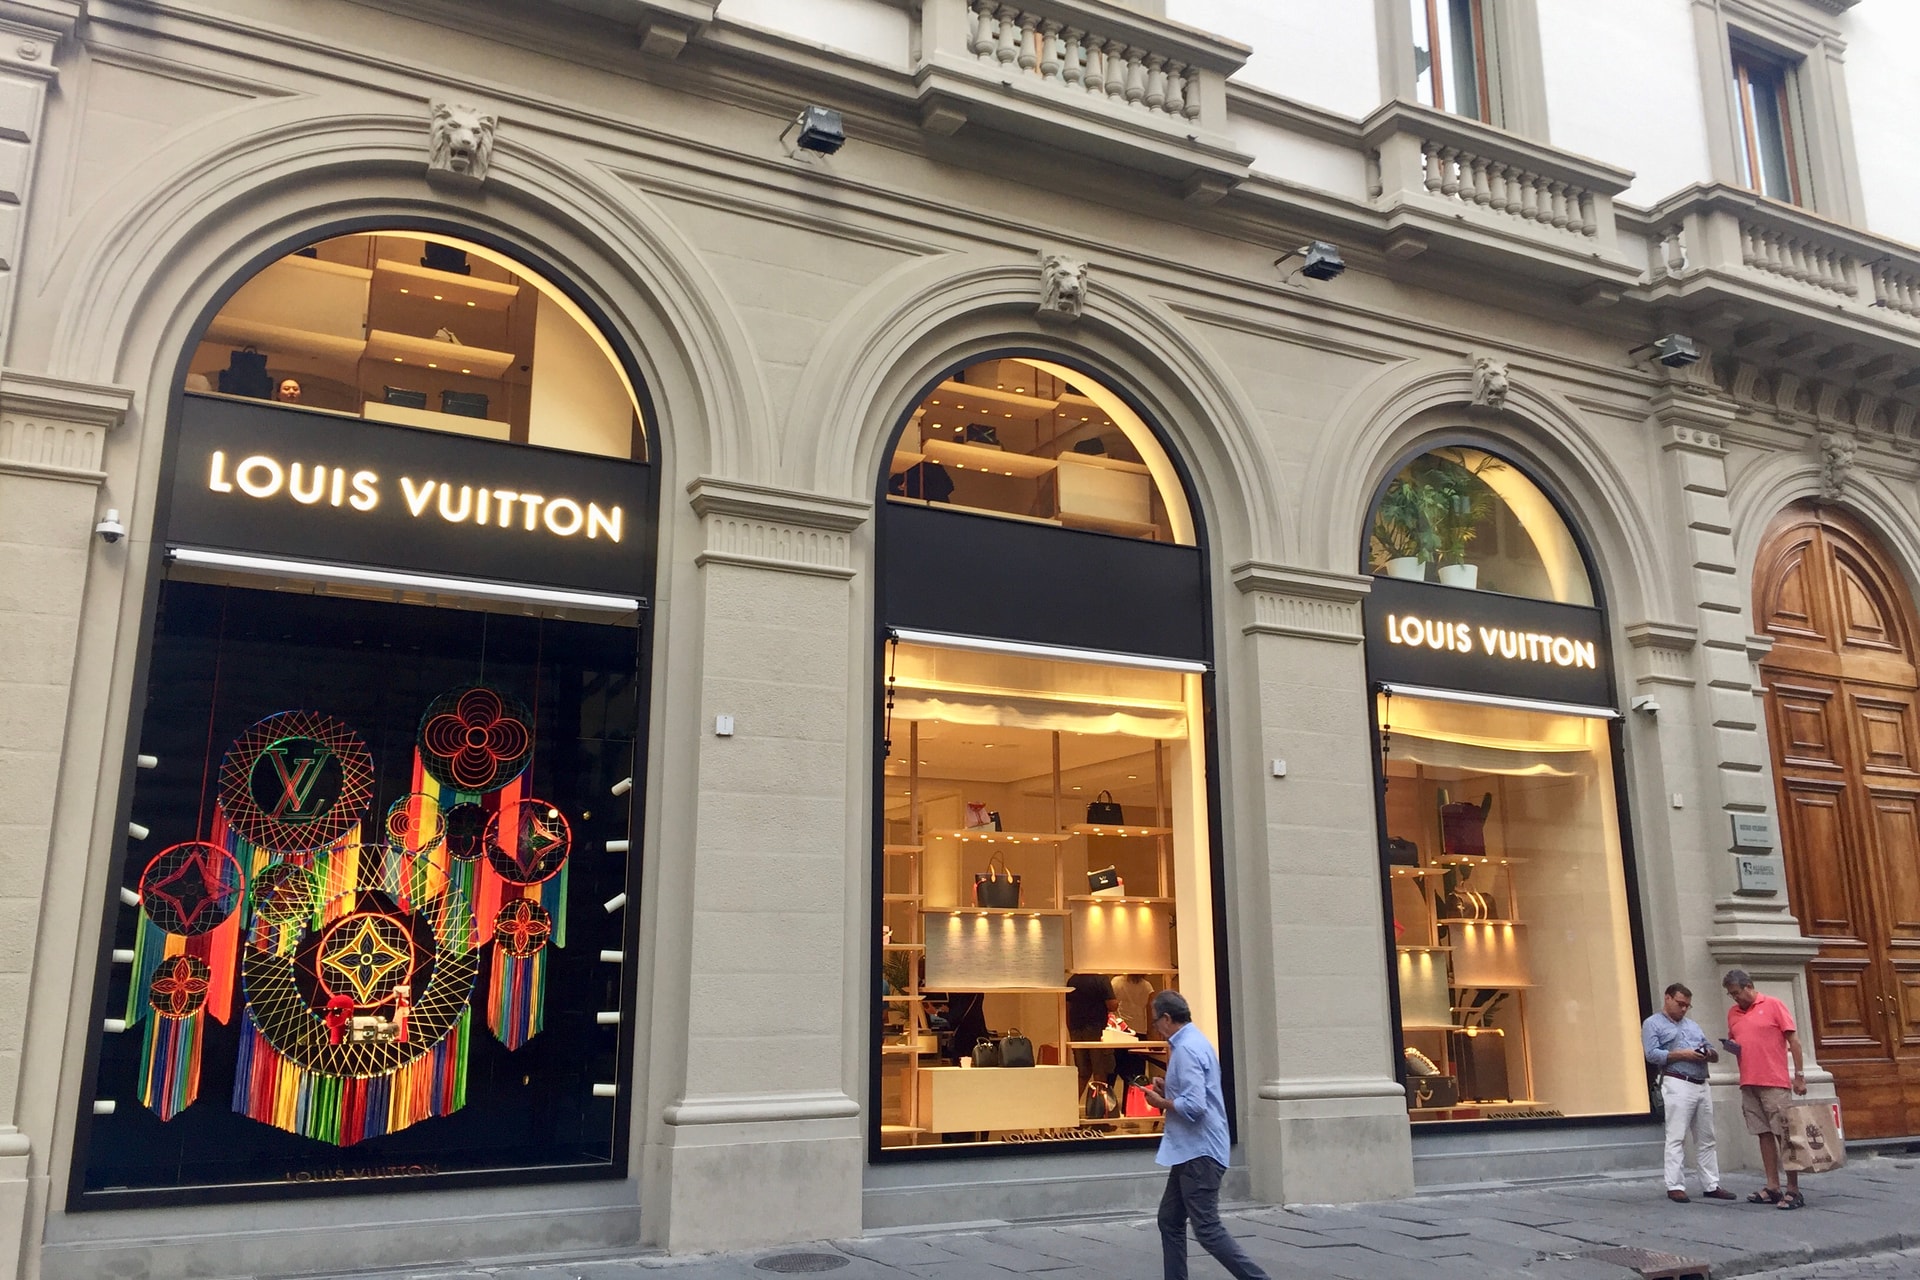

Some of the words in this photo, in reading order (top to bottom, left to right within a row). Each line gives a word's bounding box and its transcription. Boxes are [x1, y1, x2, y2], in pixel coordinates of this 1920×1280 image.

[208, 450, 379, 511] LOUIS
[400, 476, 623, 543] VUITTON
[1387, 613, 1472, 653] LOUIS
[1478, 625, 1595, 669] VUITTON
[284, 1169, 346, 1182] LOUIS
[352, 1164, 438, 1179] VUITTON
